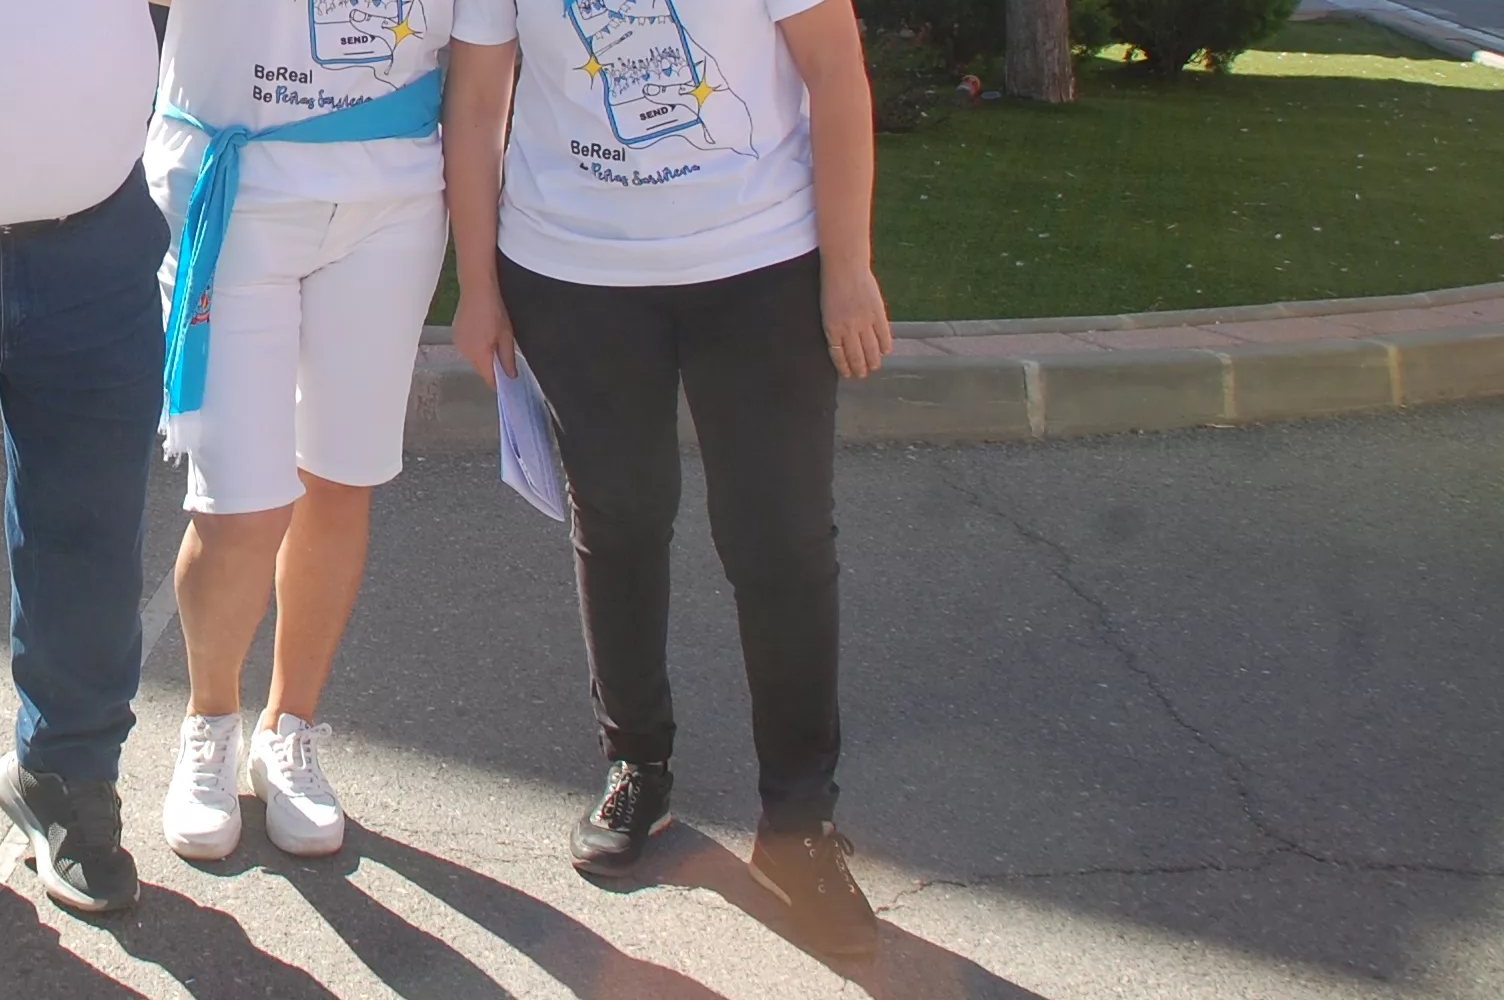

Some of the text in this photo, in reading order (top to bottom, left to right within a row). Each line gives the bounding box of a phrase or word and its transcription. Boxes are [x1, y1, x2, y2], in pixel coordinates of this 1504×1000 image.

[340, 35, 369, 45] SEND
[254, 64, 313, 84] BeReal
[252, 85, 273, 103] Be
[639, 106, 669, 121] SEND
[570, 139, 626, 162] BeReal
